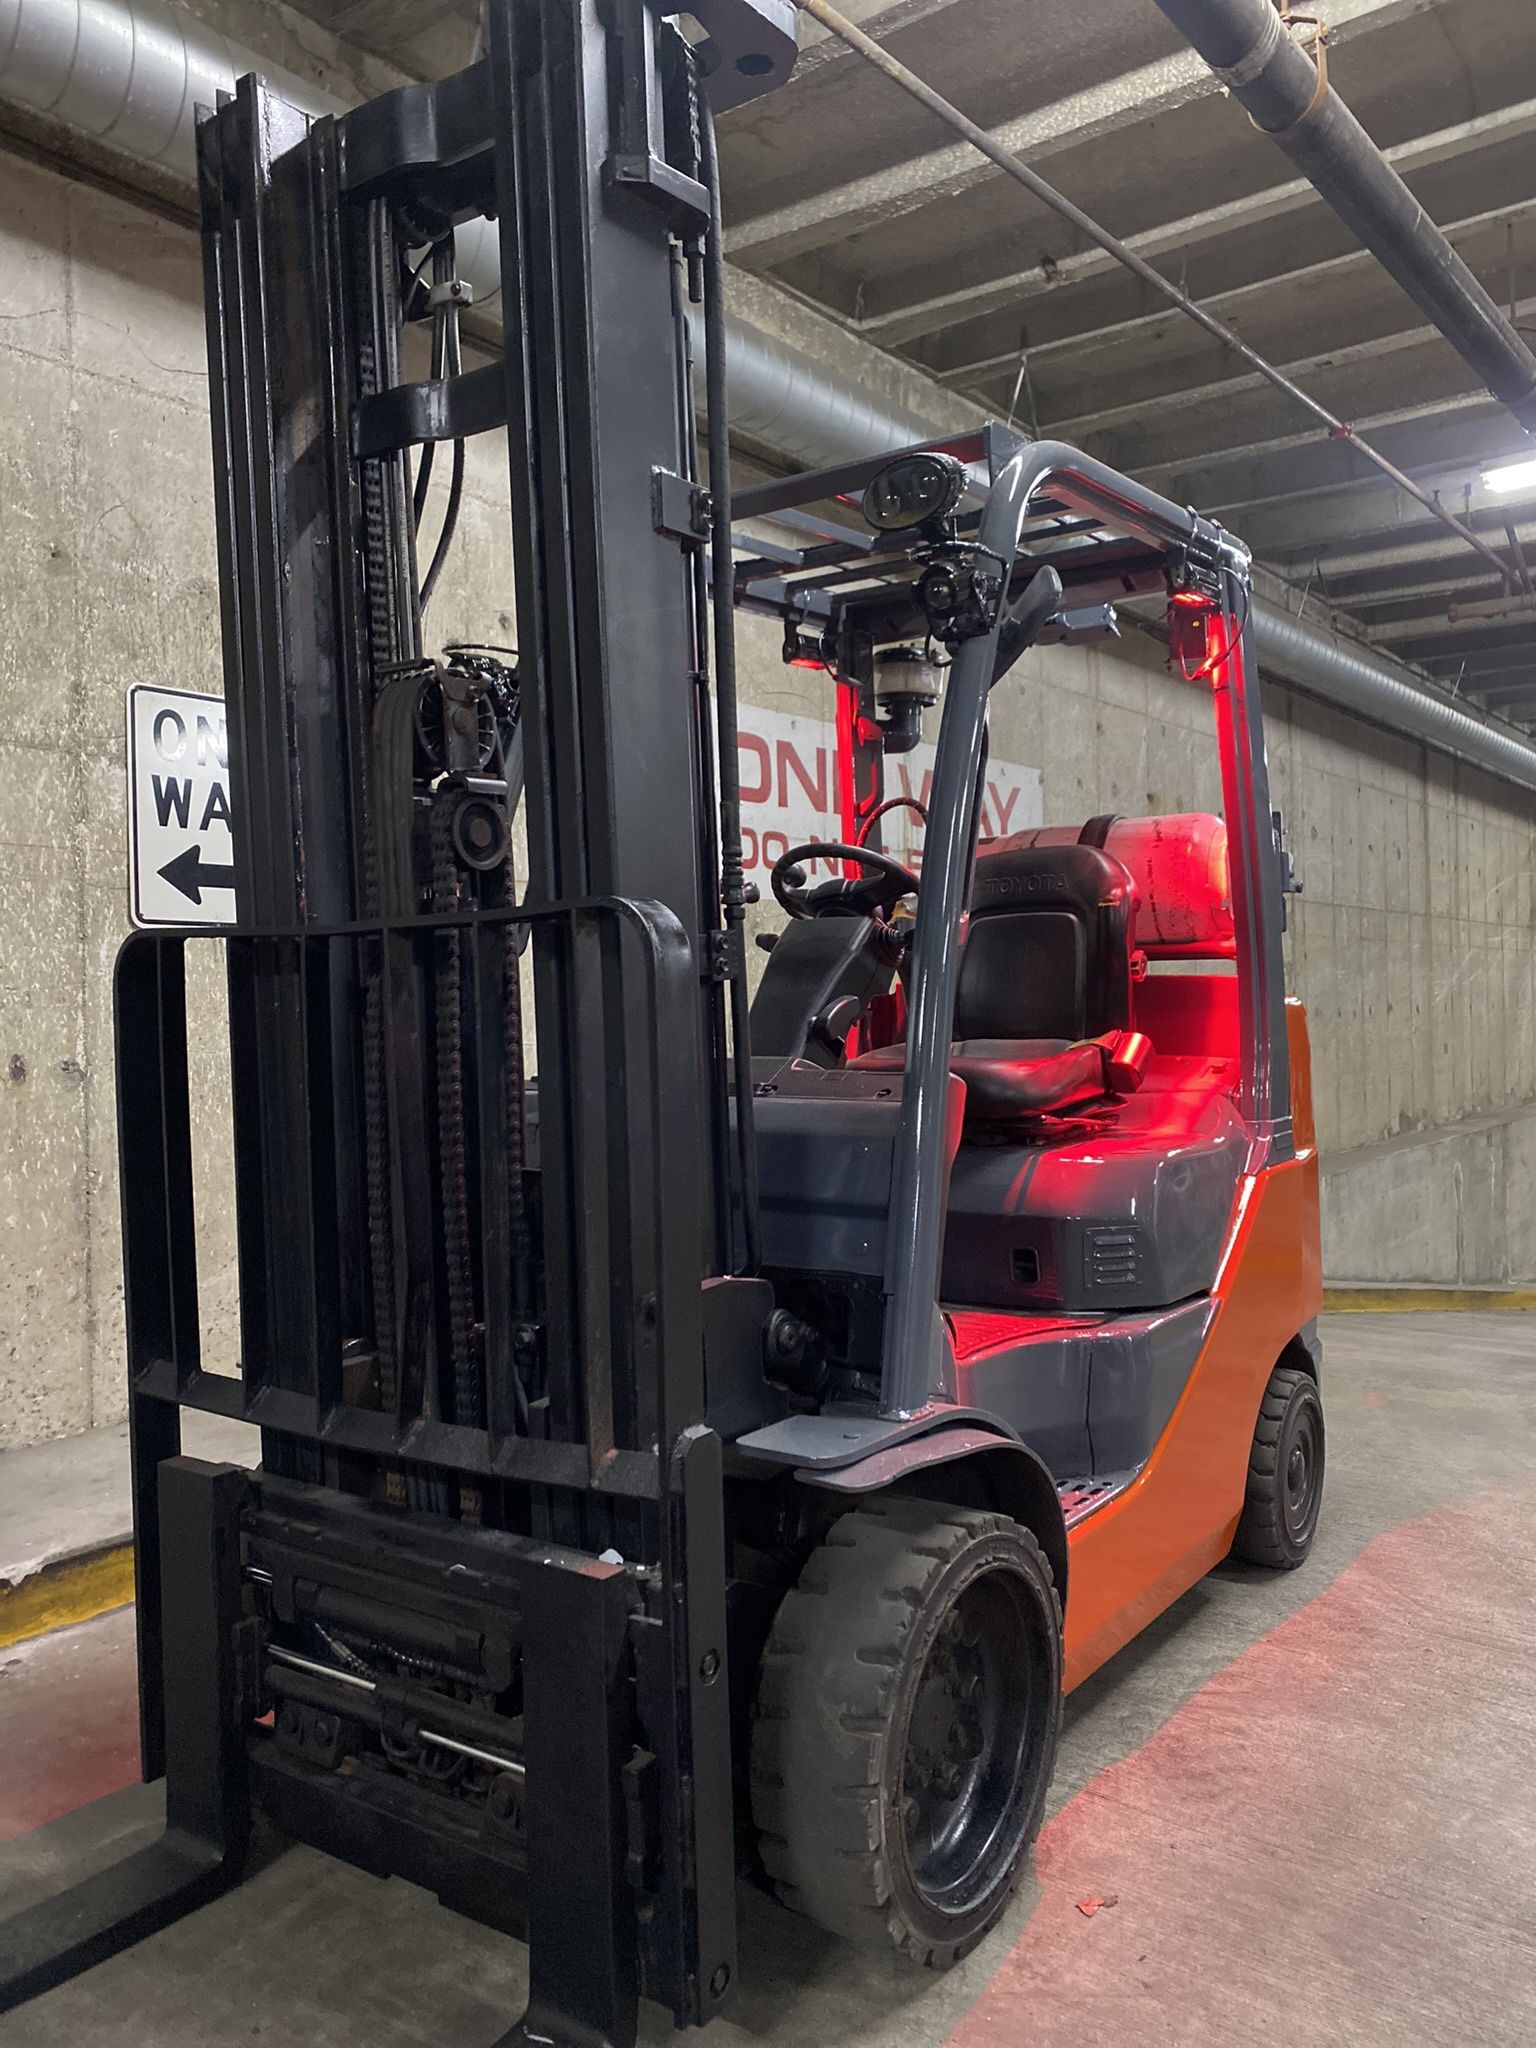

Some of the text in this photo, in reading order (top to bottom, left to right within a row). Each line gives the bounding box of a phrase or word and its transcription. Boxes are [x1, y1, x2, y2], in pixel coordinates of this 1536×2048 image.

[153, 709, 229, 769] ON
[737, 731, 842, 815] ON
[152, 775, 232, 833] WA
[985, 873, 1072, 897] TOYOTA
